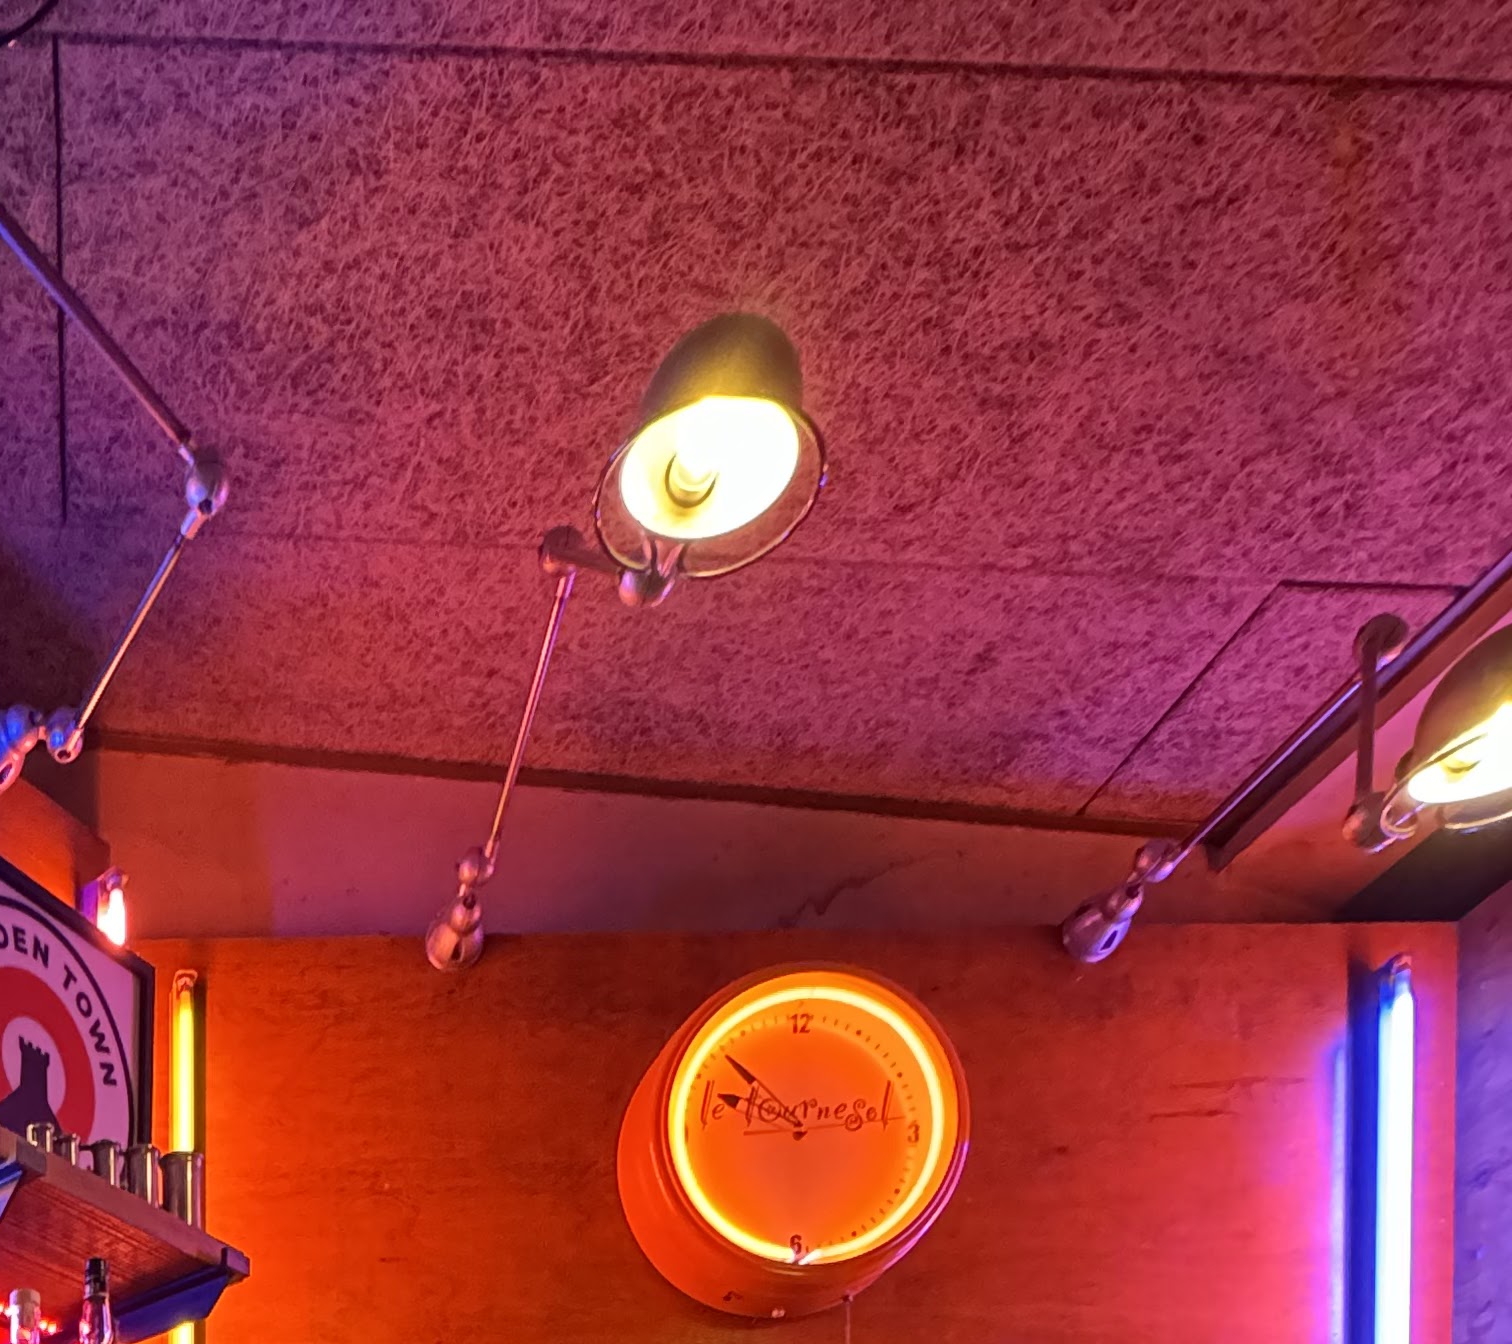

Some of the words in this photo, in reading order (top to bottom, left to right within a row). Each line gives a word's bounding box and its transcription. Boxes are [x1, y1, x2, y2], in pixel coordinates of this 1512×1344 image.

[63, 965, 117, 1088] TOWN
[787, 1012, 814, 1035] 12
[907, 1120, 921, 1145] 3
